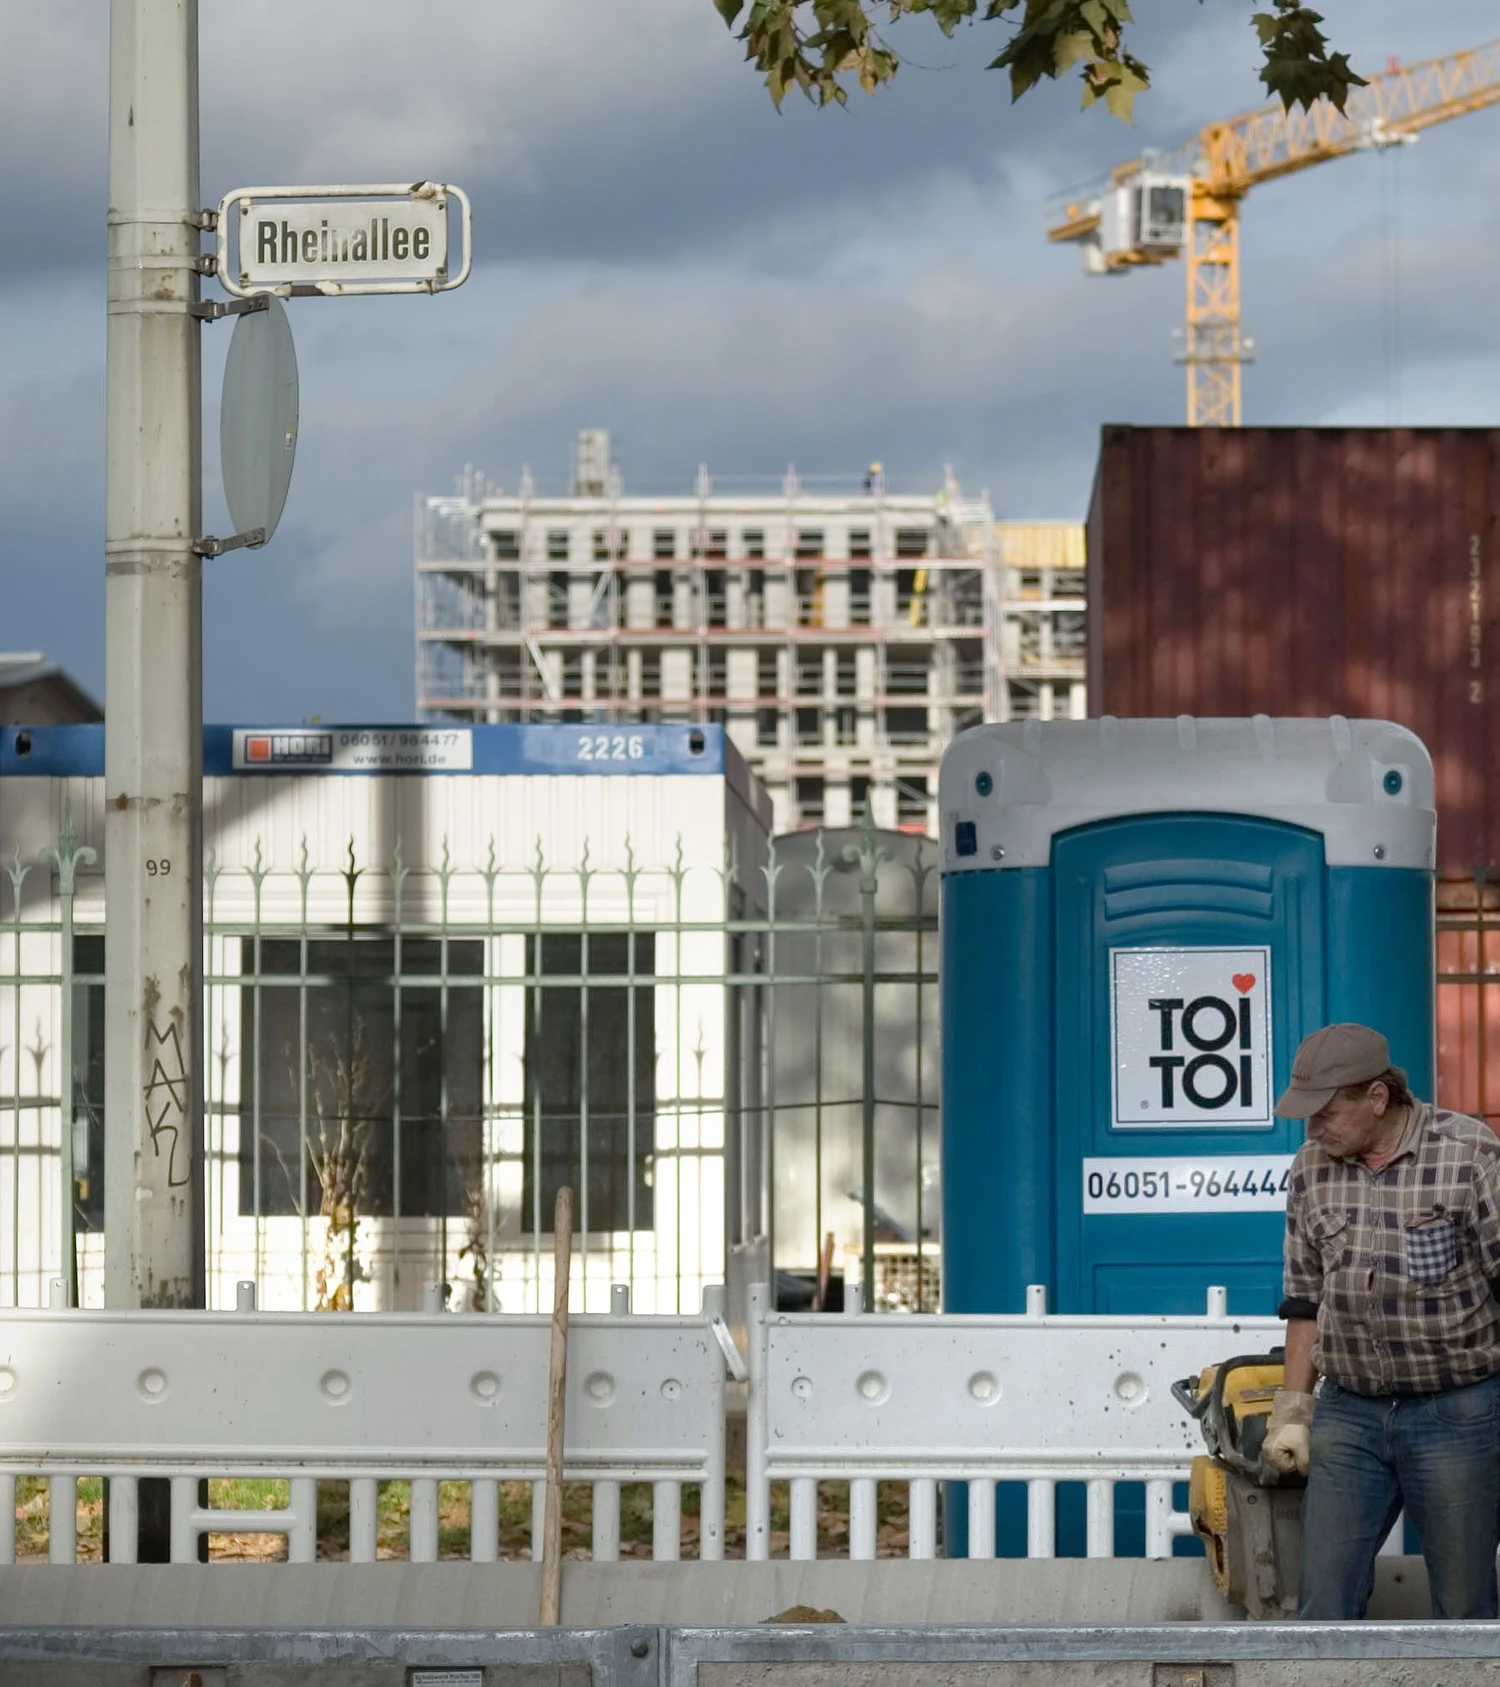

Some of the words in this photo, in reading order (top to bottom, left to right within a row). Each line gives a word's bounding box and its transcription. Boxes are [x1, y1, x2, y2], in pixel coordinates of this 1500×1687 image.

[257, 217, 430, 264] Rheinallee
[273, 737, 330, 755] HORI
[578, 735, 644, 761] 2226
[353, 753, 447, 766] www.hori.de
[146, 859, 171, 876] 99
[1148, 995, 1252, 1052] TOI
[1149, 1053, 1253, 1110] TOI
